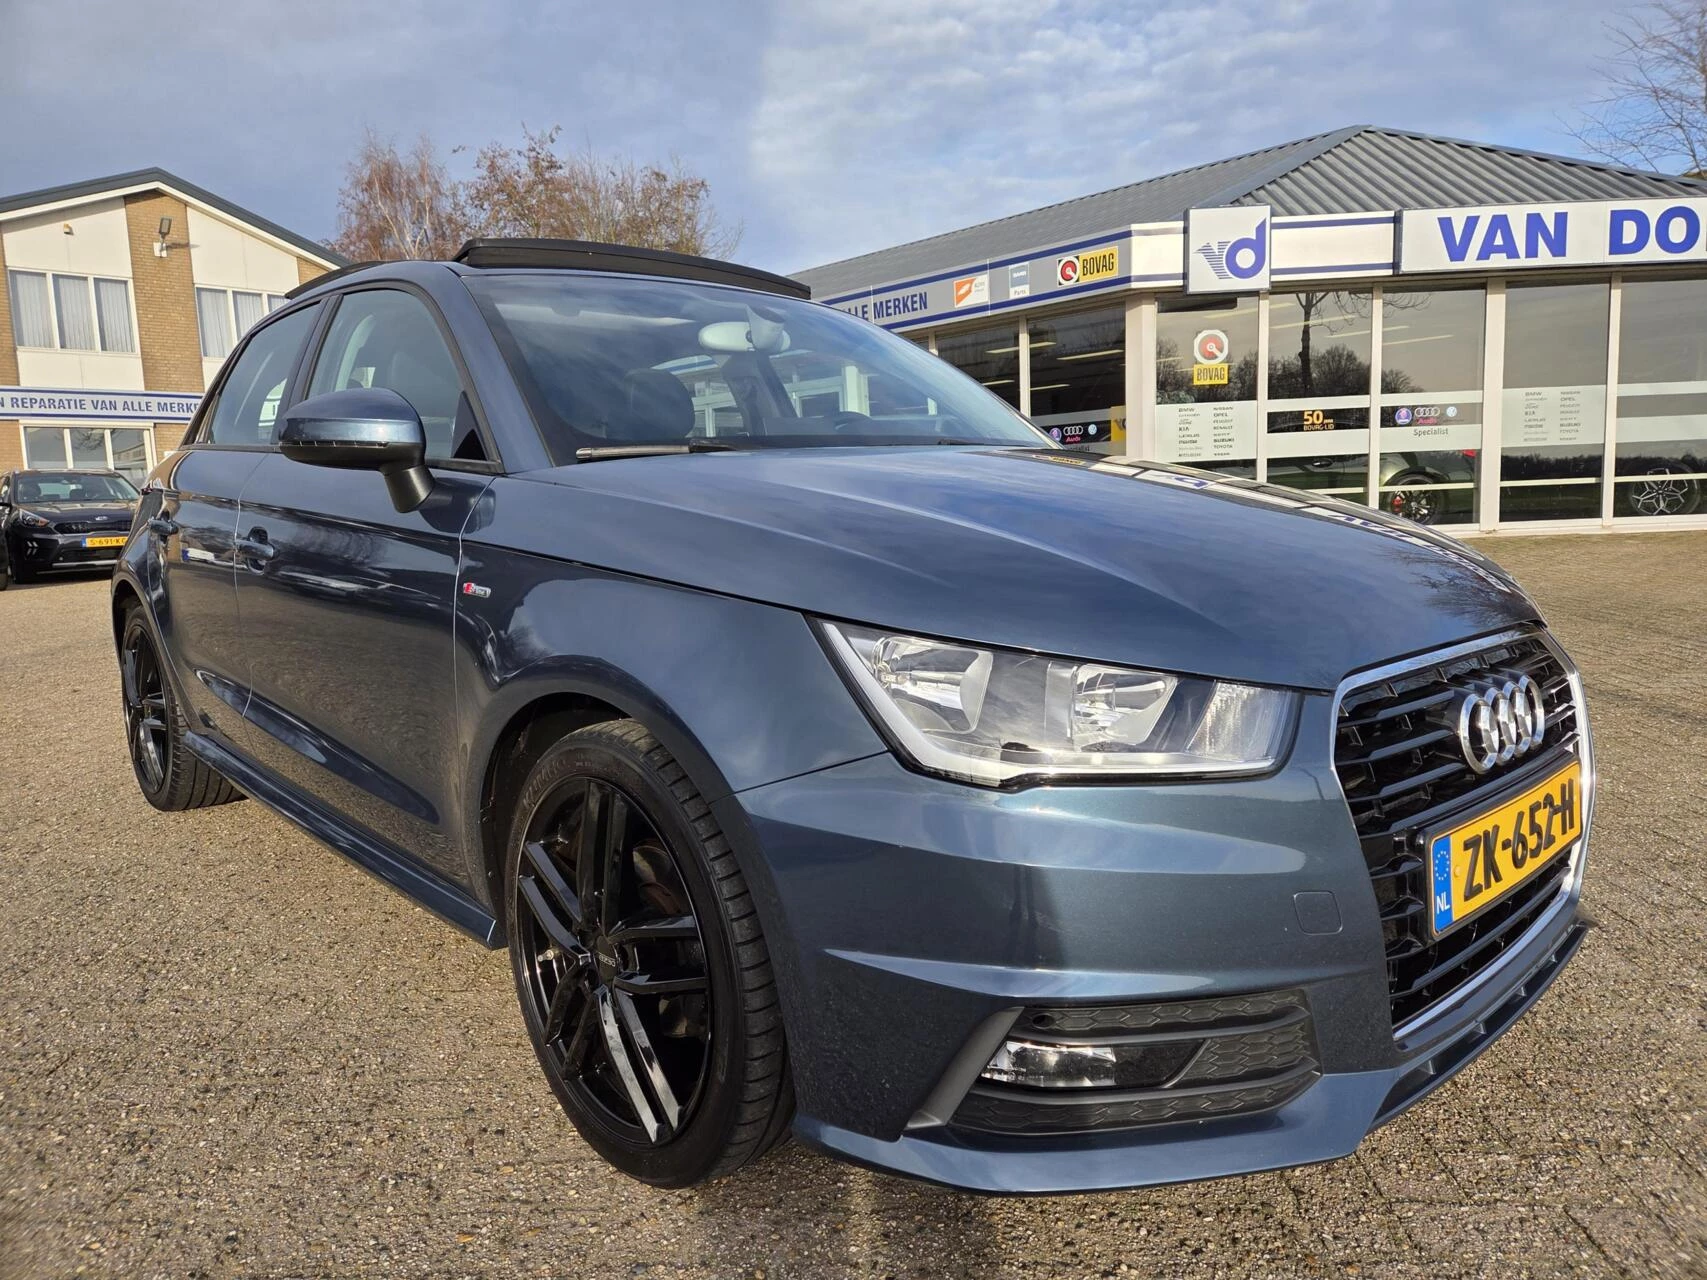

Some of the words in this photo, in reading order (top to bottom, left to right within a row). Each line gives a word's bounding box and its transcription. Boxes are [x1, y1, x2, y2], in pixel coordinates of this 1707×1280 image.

[1437, 211, 1569, 263] VAN
[1608, 205, 1707, 256] DO
[1082, 252, 1115, 277] BOVAG
[873, 292, 928, 320] MERKEN
[1196, 366, 1226, 382] BOVAG
[10, 396, 87, 411] REPARATIE
[91, 398, 118, 411] VAN
[122, 400, 153, 412] ALLE
[1303, 409, 1324, 425] 50
[1413, 428, 1449, 437] Specialist
[1462, 777, 1575, 903] ZK-652-H
[1436, 890, 1451, 915] NL
